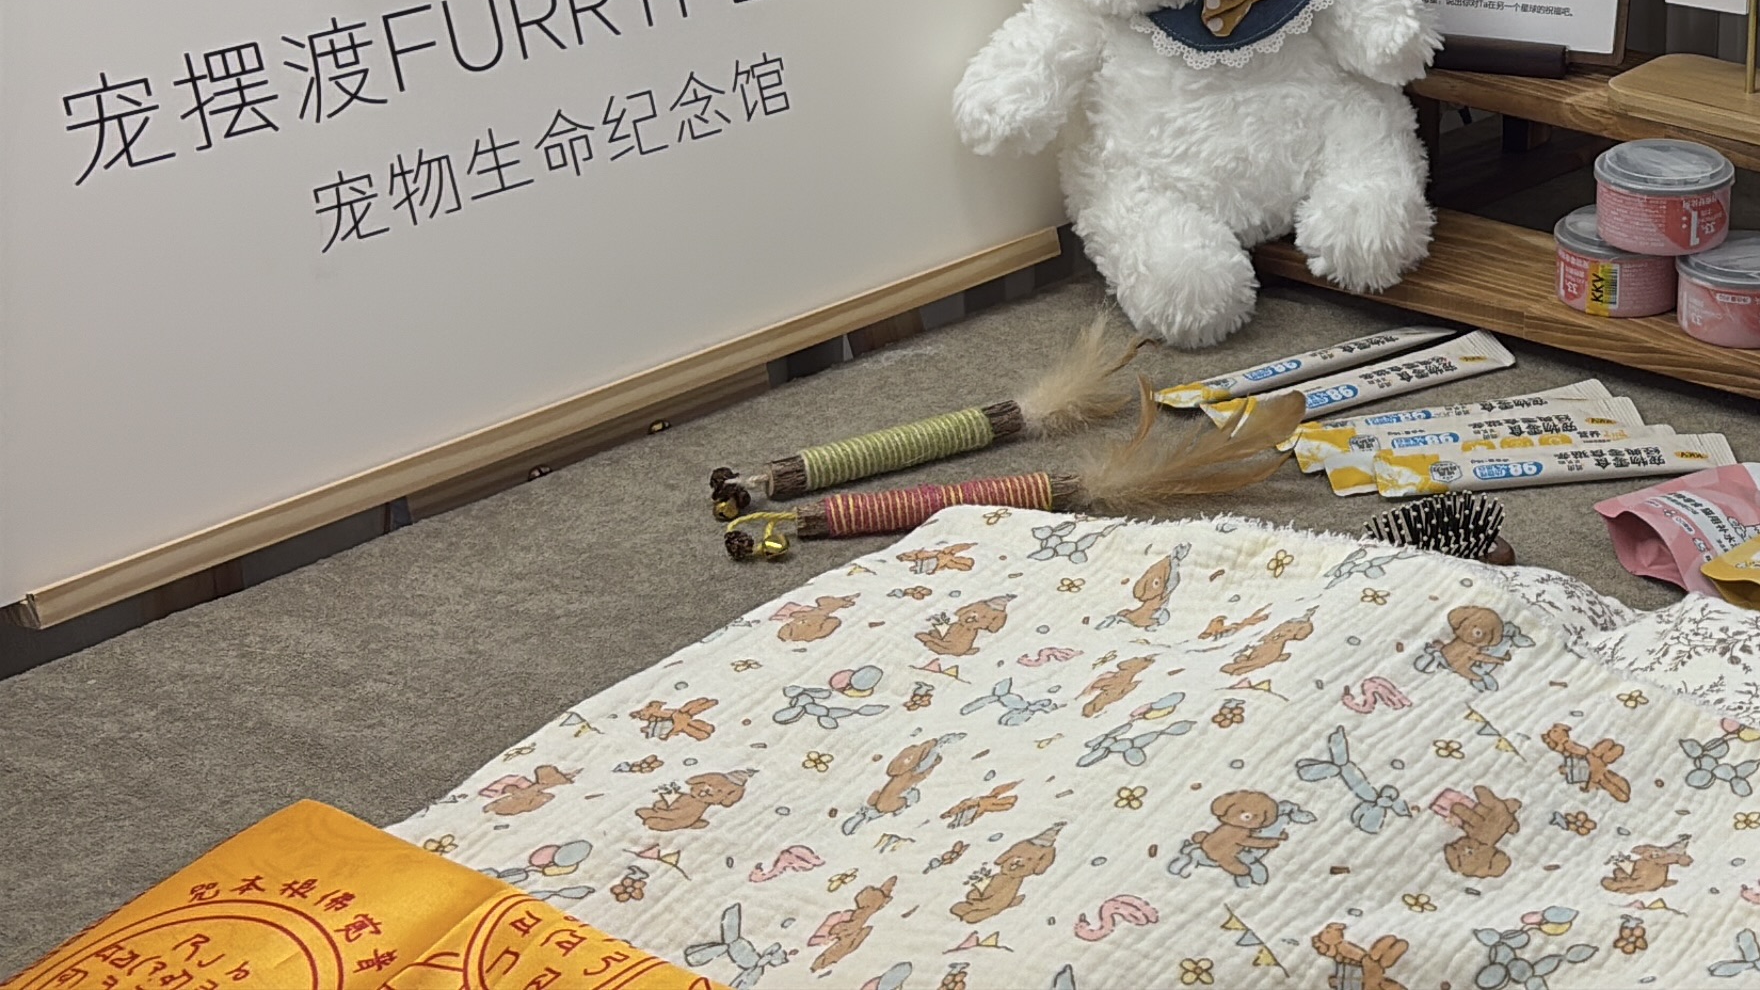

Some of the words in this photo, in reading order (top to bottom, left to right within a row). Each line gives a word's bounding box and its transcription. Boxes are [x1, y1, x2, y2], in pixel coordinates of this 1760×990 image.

[311, 51, 792, 254] 宠物生命纪念馆
[1591, 273, 1607, 303] KKV
[1594, 452, 1666, 470] 宠物零食
